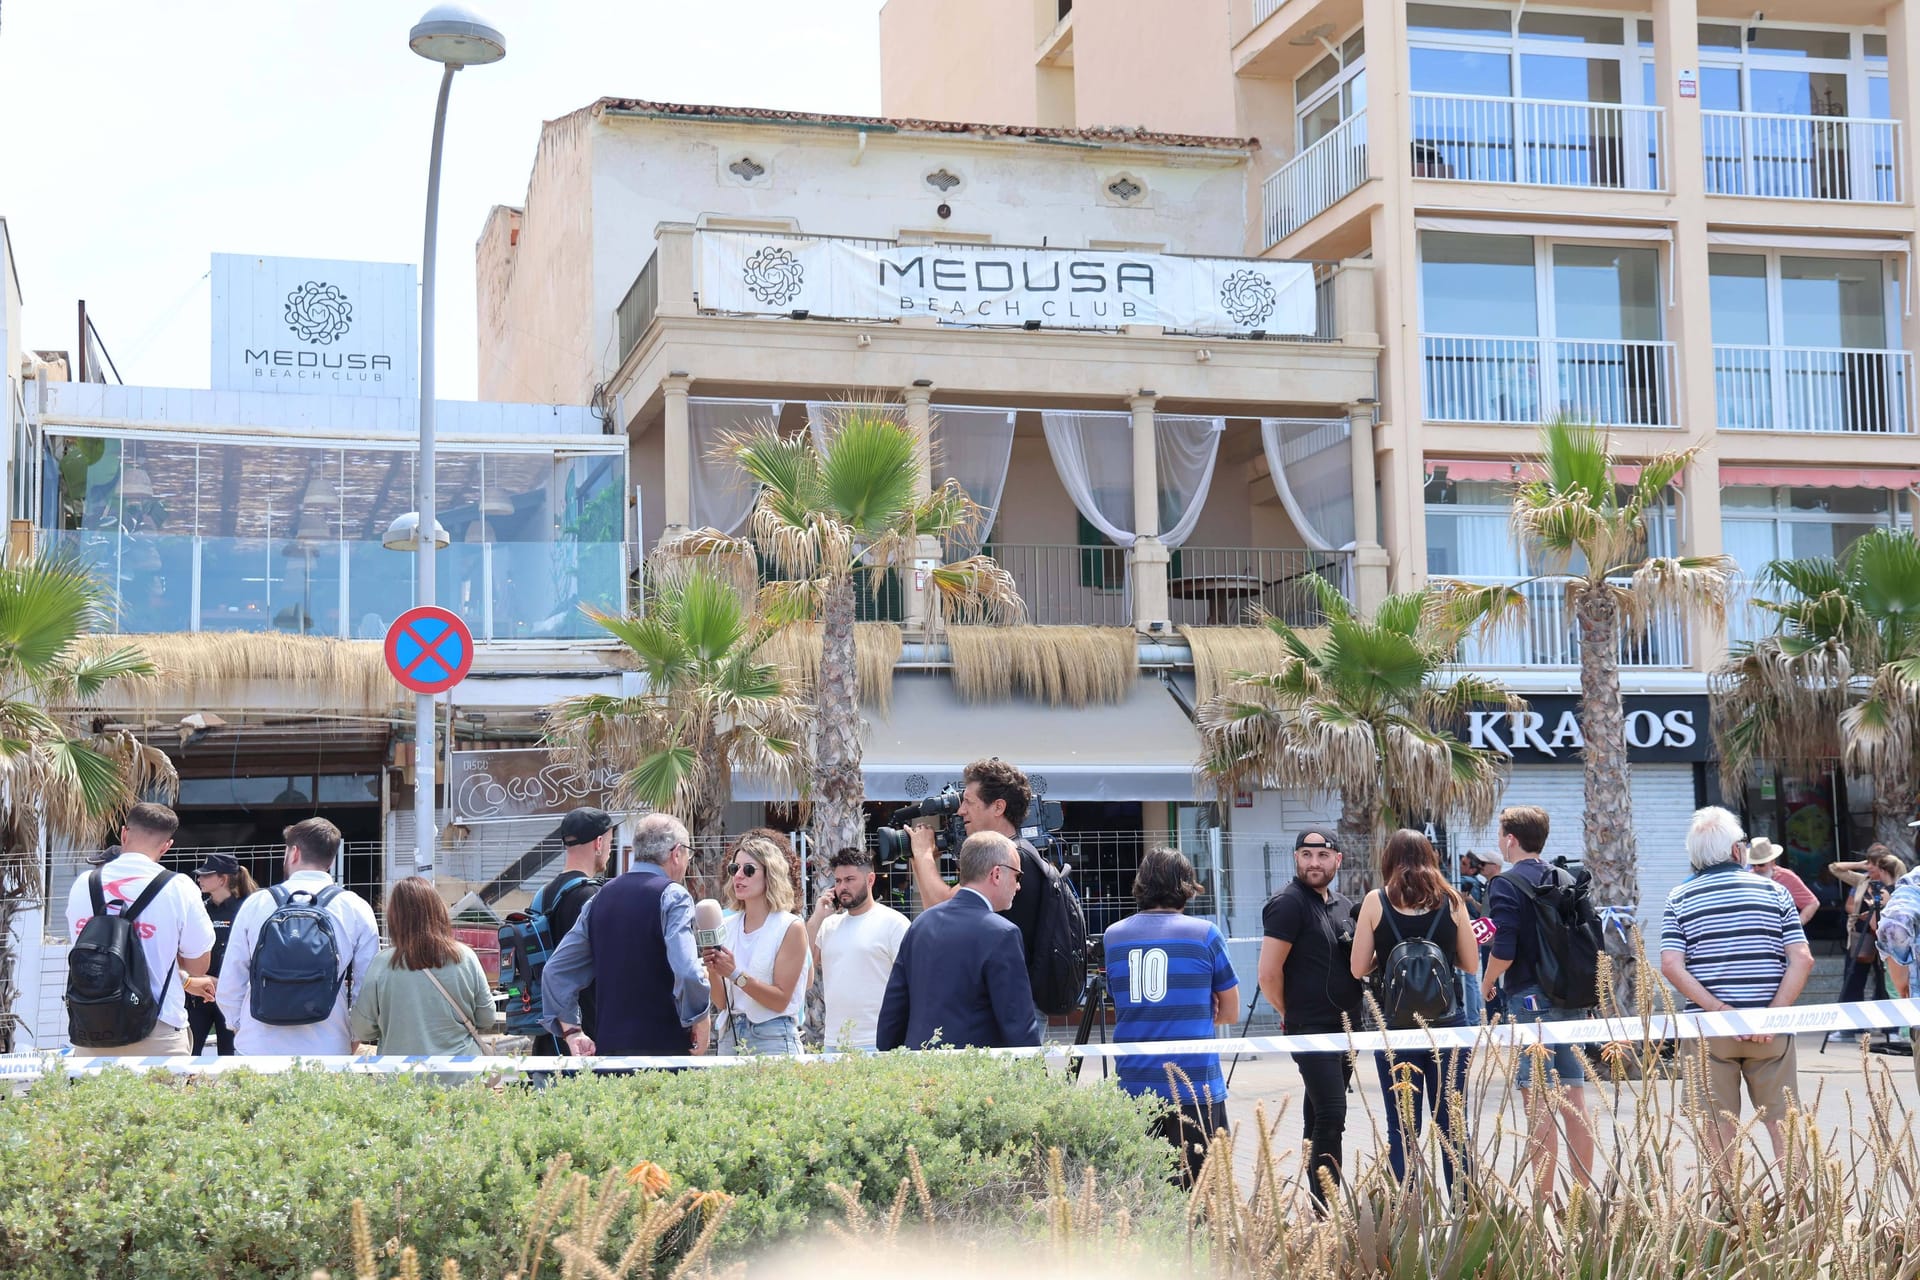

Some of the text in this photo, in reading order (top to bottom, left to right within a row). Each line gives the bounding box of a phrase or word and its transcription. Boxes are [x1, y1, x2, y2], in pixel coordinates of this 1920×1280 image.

[879, 256, 1154, 295] MEDUSA
[899, 296, 1137, 318] BEACH CLUB
[245, 349, 391, 370] MEDUSA
[255, 367, 383, 382] BEACH CLUB
[1465, 709, 1697, 758] KRAOS
[463, 760, 489, 771] DISCO
[1128, 948, 1169, 1003] 10
